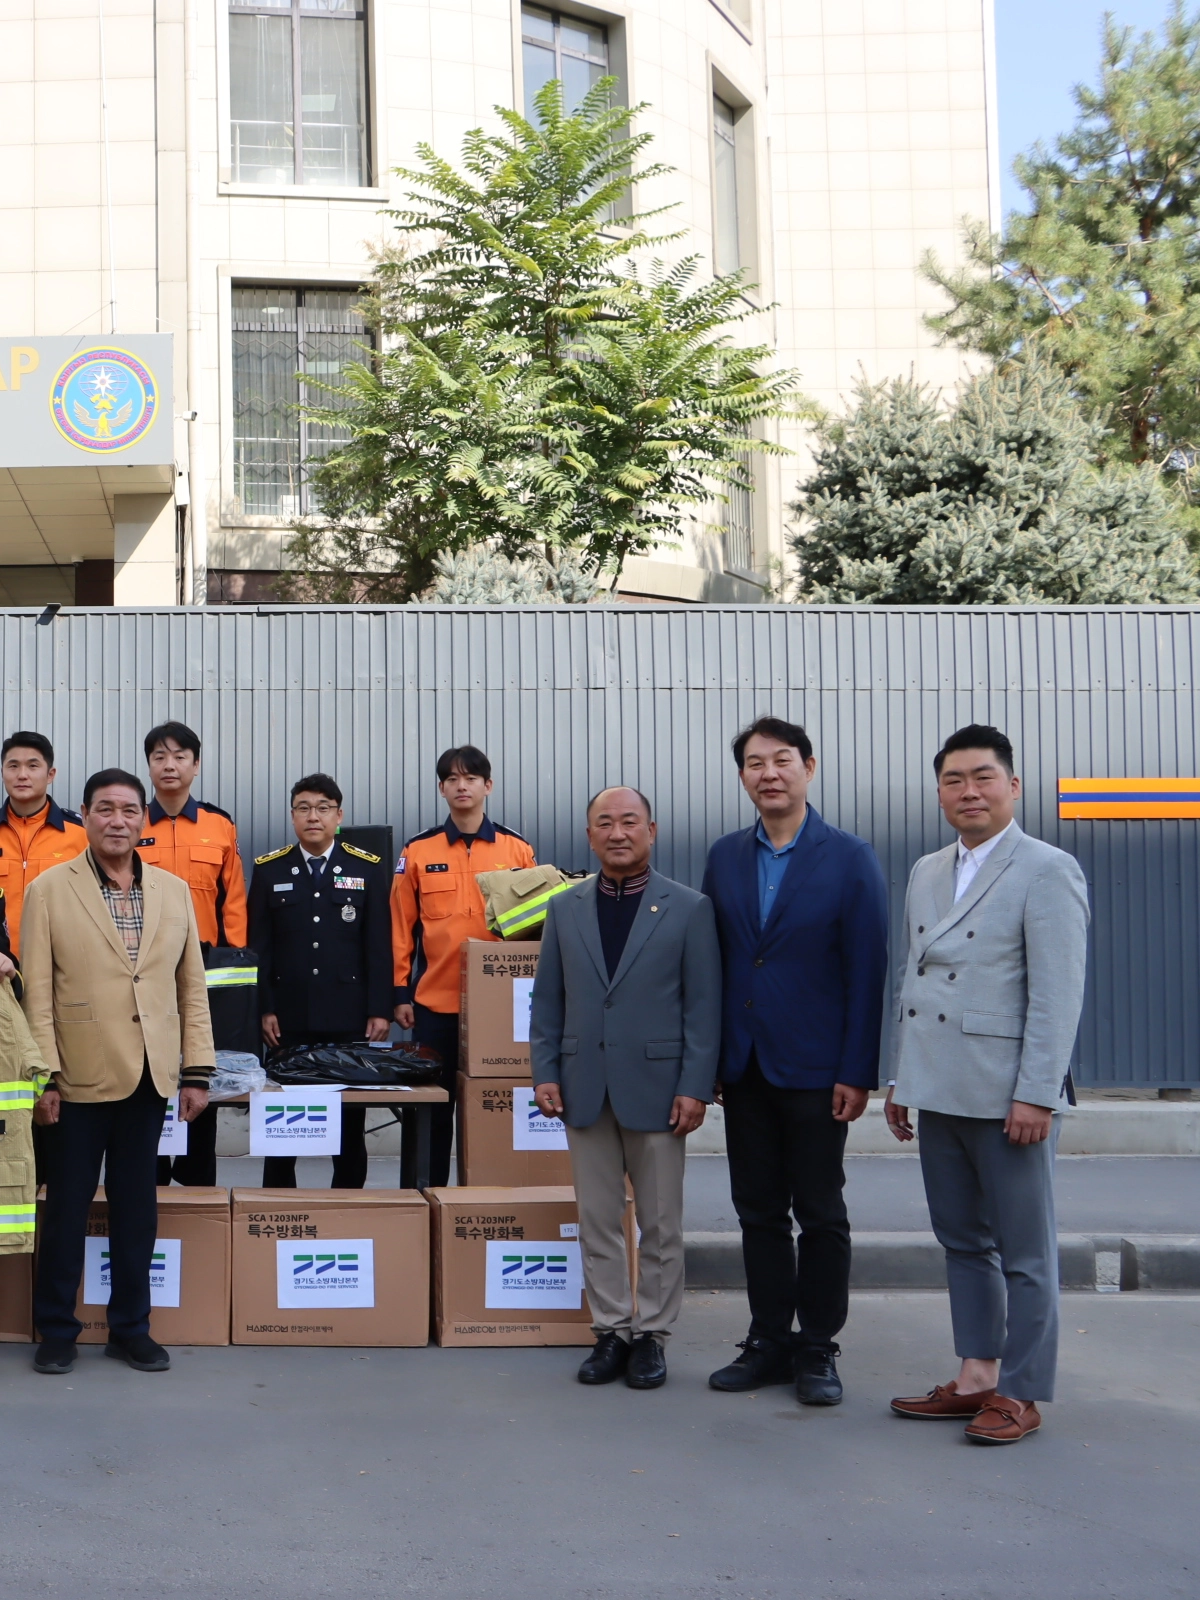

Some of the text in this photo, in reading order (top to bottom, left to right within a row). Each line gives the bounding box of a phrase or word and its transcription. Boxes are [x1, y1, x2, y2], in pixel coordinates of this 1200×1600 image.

[482, 954, 540, 962] SCA 1203NFP
[482, 963, 537, 978] 특수방화
[482, 1090, 499, 1098] SCA
[265, 1126, 327, 1134] 경기도소방재난본부
[248, 1213, 310, 1222] SCA 1203NFP
[454, 1215, 517, 1225] SCA 1203NFP
[247, 1224, 318, 1239] 특수방화복
[454, 1226, 525, 1240] 특수방화복
[293, 1277, 359, 1285] 경기도소방재난본부
[502, 1278, 567, 1286] 경기도소방재난본부
